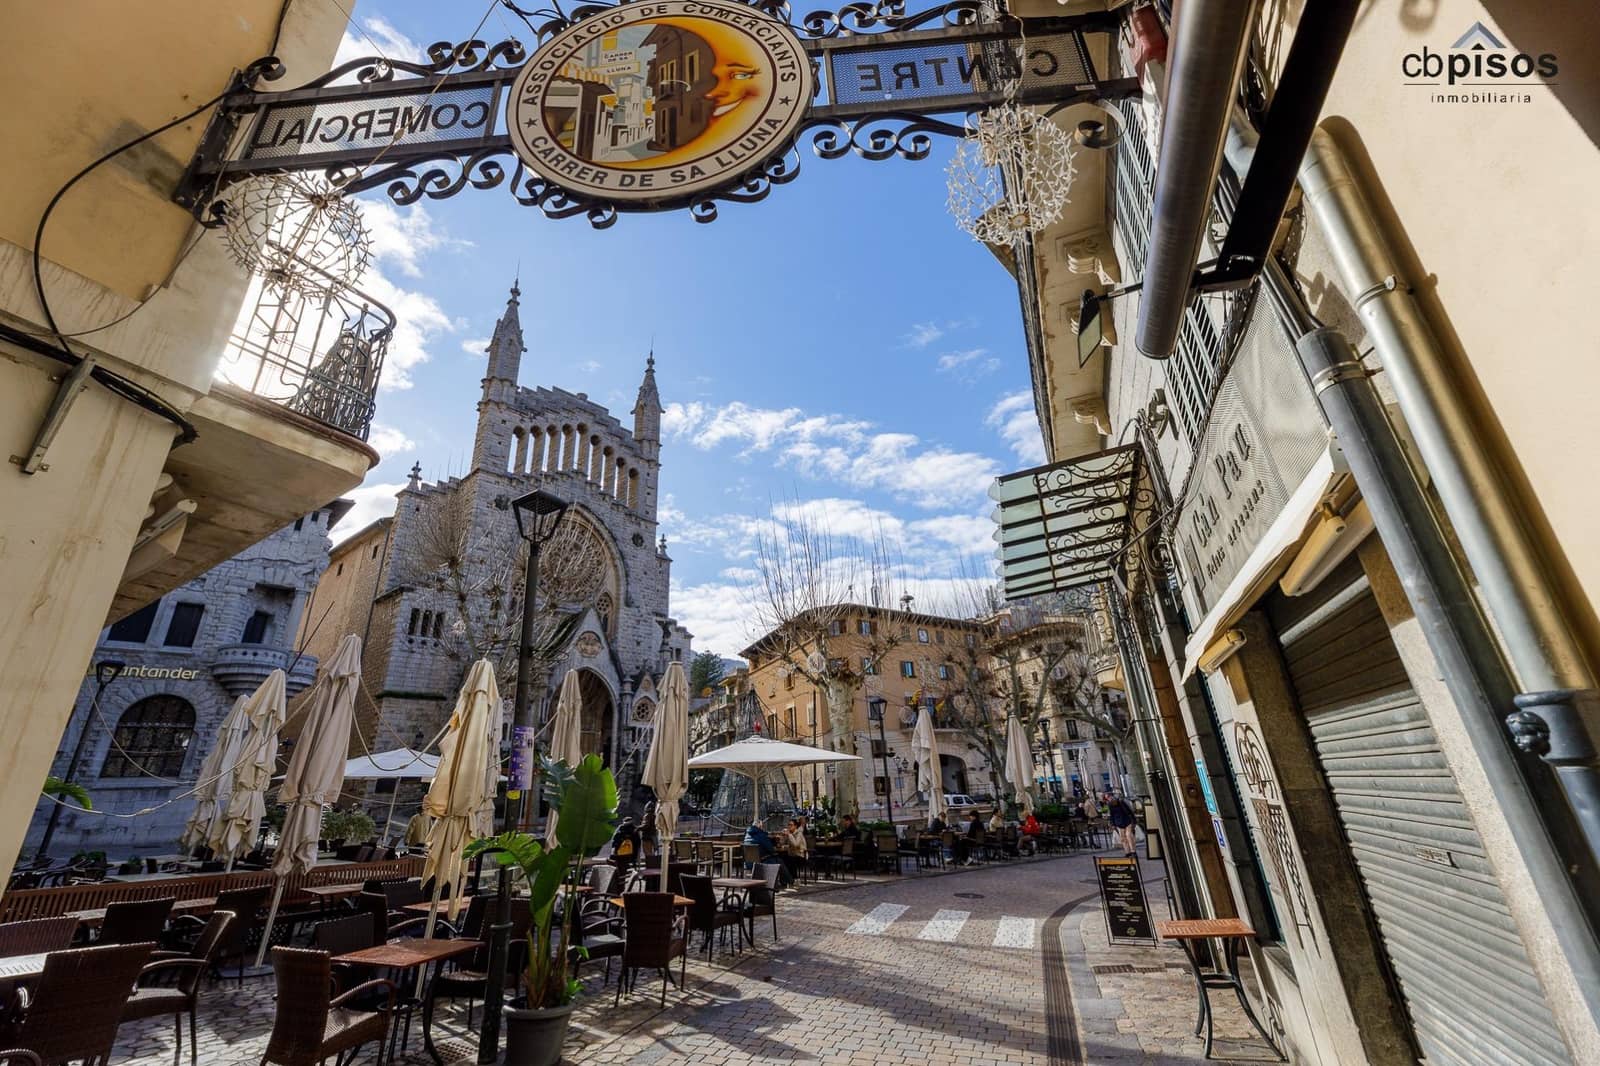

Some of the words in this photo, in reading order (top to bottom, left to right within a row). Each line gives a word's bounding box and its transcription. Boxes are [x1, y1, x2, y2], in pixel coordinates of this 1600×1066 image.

[522, 10, 626, 108] ASSOCIACIÓ
[640, 4, 668, 16] DE
[683, 3, 797, 83] COMERCIANTS
[531, 136, 609, 184] CARRER
[619, 174, 654, 187] DE
[670, 165, 707, 184] SA
[715, 117, 783, 168] LLUNA
